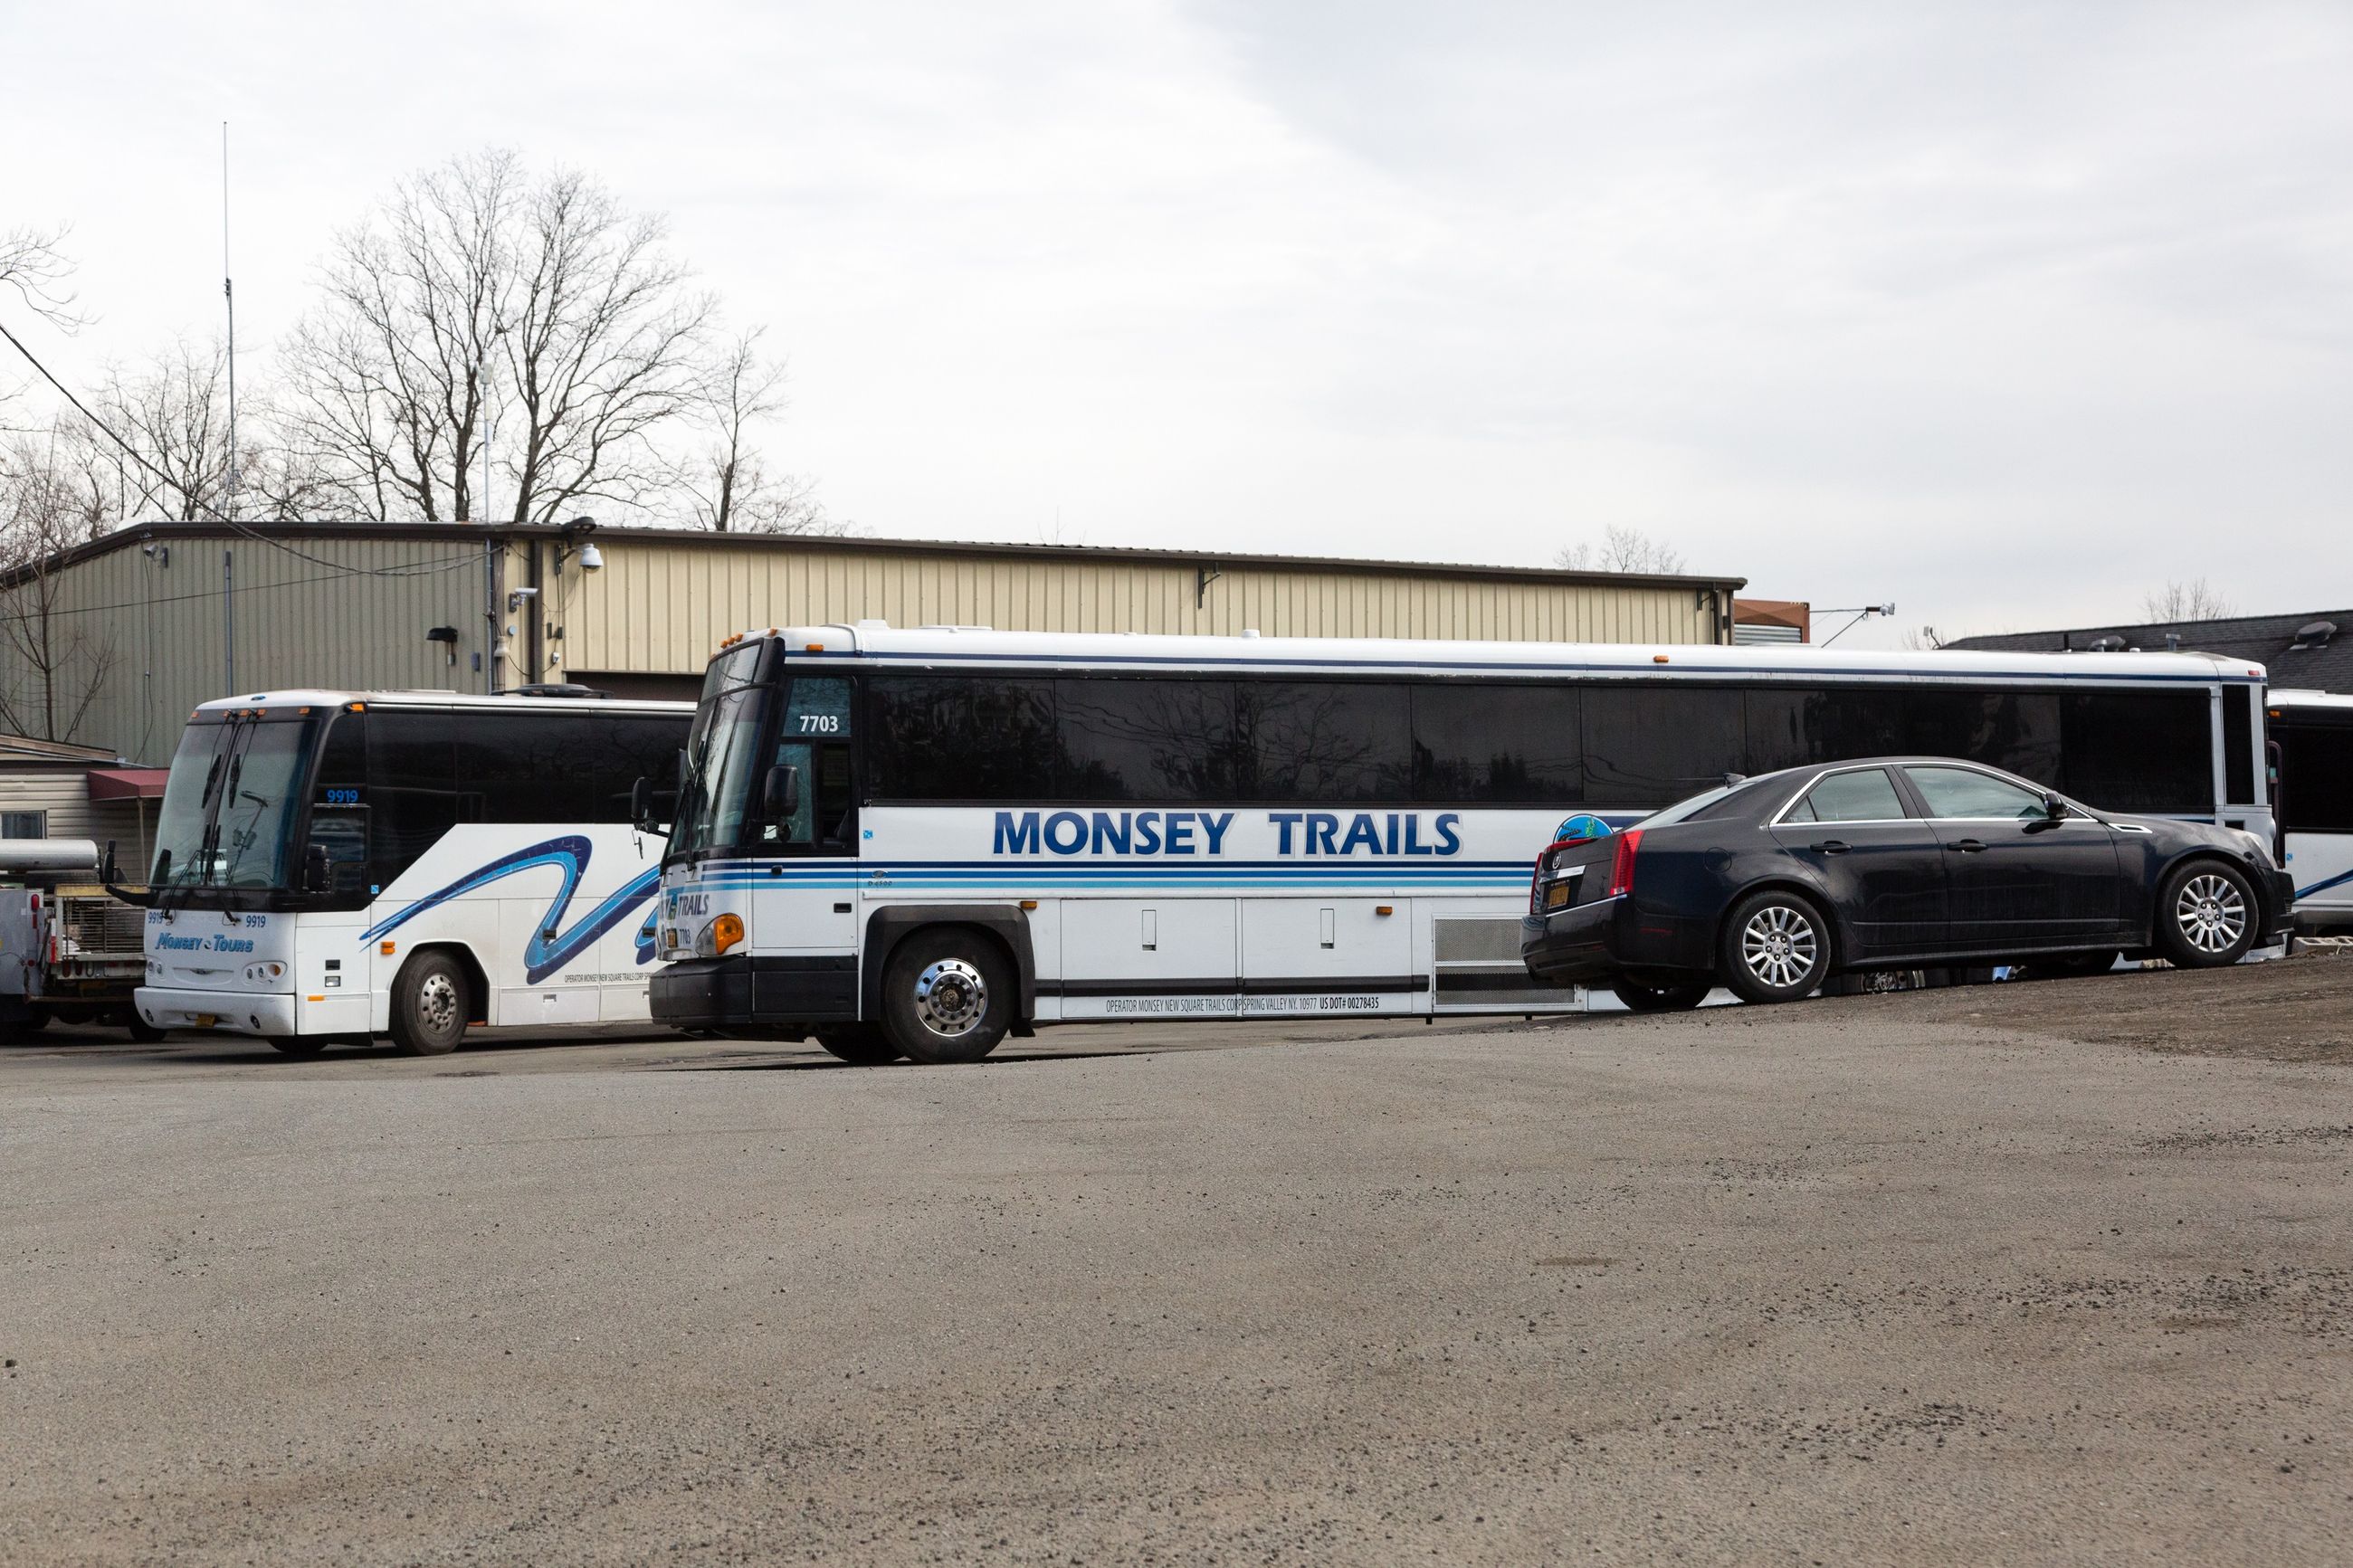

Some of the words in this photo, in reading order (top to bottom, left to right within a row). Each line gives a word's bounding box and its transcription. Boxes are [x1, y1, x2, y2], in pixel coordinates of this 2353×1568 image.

[800, 716, 838, 732] 7703
[327, 790, 358, 803] 9919
[993, 812, 1236, 856] MONSEY
[1269, 813, 1462, 856] TRAILS
[678, 894, 710, 916] TRAILS
[148, 912, 163, 924] 9919
[246, 916, 266, 927] 9919
[155, 933, 204, 950] MONSEY
[214, 934, 254, 952] TOURS
[680, 928, 691, 944] 7703
[1106, 999, 1137, 1012] OPERATOR
[1138, 999, 1164, 1012] MONSEY
[1165, 999, 1179, 1012] NEW
[1181, 998, 1204, 1012] SQUARE
[1205, 998, 1225, 1011] TRAILS
[1226, 998, 1242, 1011] CORP
[1243, 998, 1264, 1011] SPRING
[1265, 998, 1287, 1011] VALLEY
[1300, 997, 1317, 1010] 10977
[1319, 997, 1329, 1010] US
[1329, 997, 1347, 1010] DOT#
[1348, 996, 1379, 1009] 00278435
